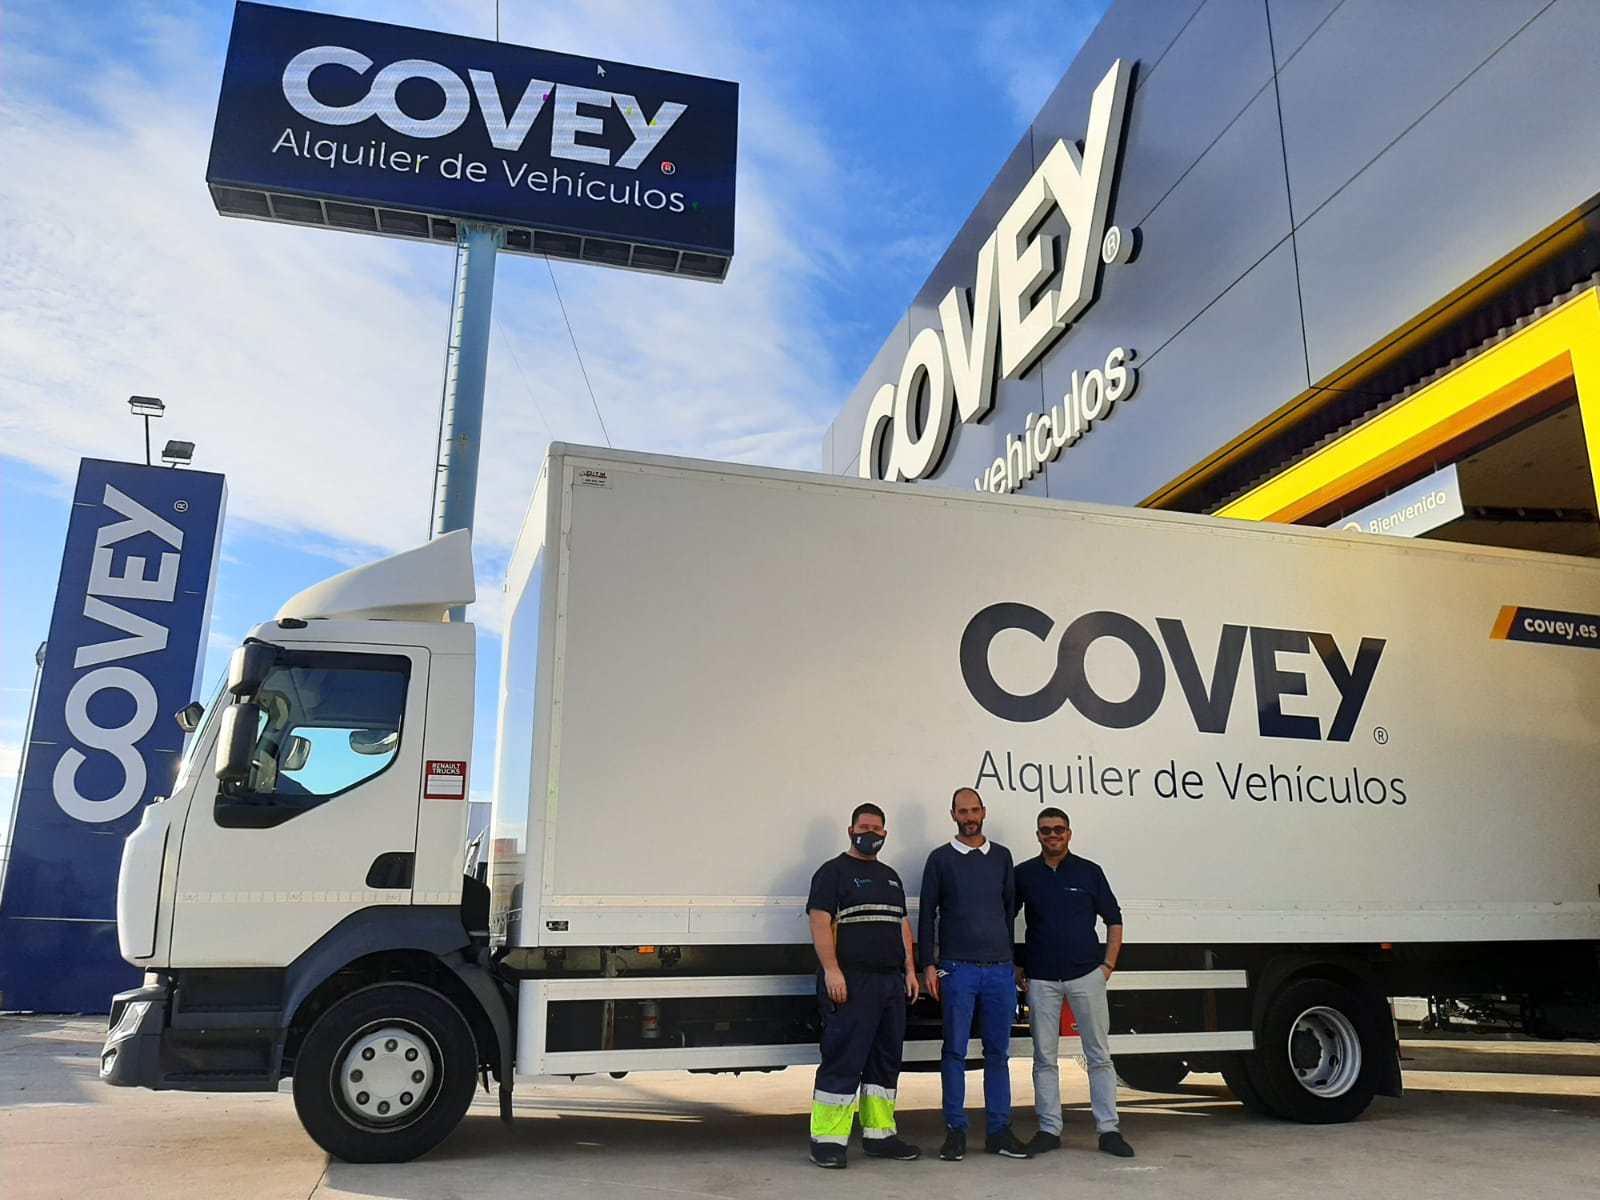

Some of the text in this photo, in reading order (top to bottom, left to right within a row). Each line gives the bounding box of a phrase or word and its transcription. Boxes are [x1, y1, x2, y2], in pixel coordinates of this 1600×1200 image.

[282, 45, 688, 170] COVEY
[271, 127, 686, 213] Alquiler de Vehículos
[1369, 491, 1447, 534] Bienvenido
[52, 483, 184, 823] COVEY
[959, 602, 1387, 742] COVEY
[1523, 618, 1598, 640] covey.es
[974, 750, 1408, 806] Alquiler de Vehículos
